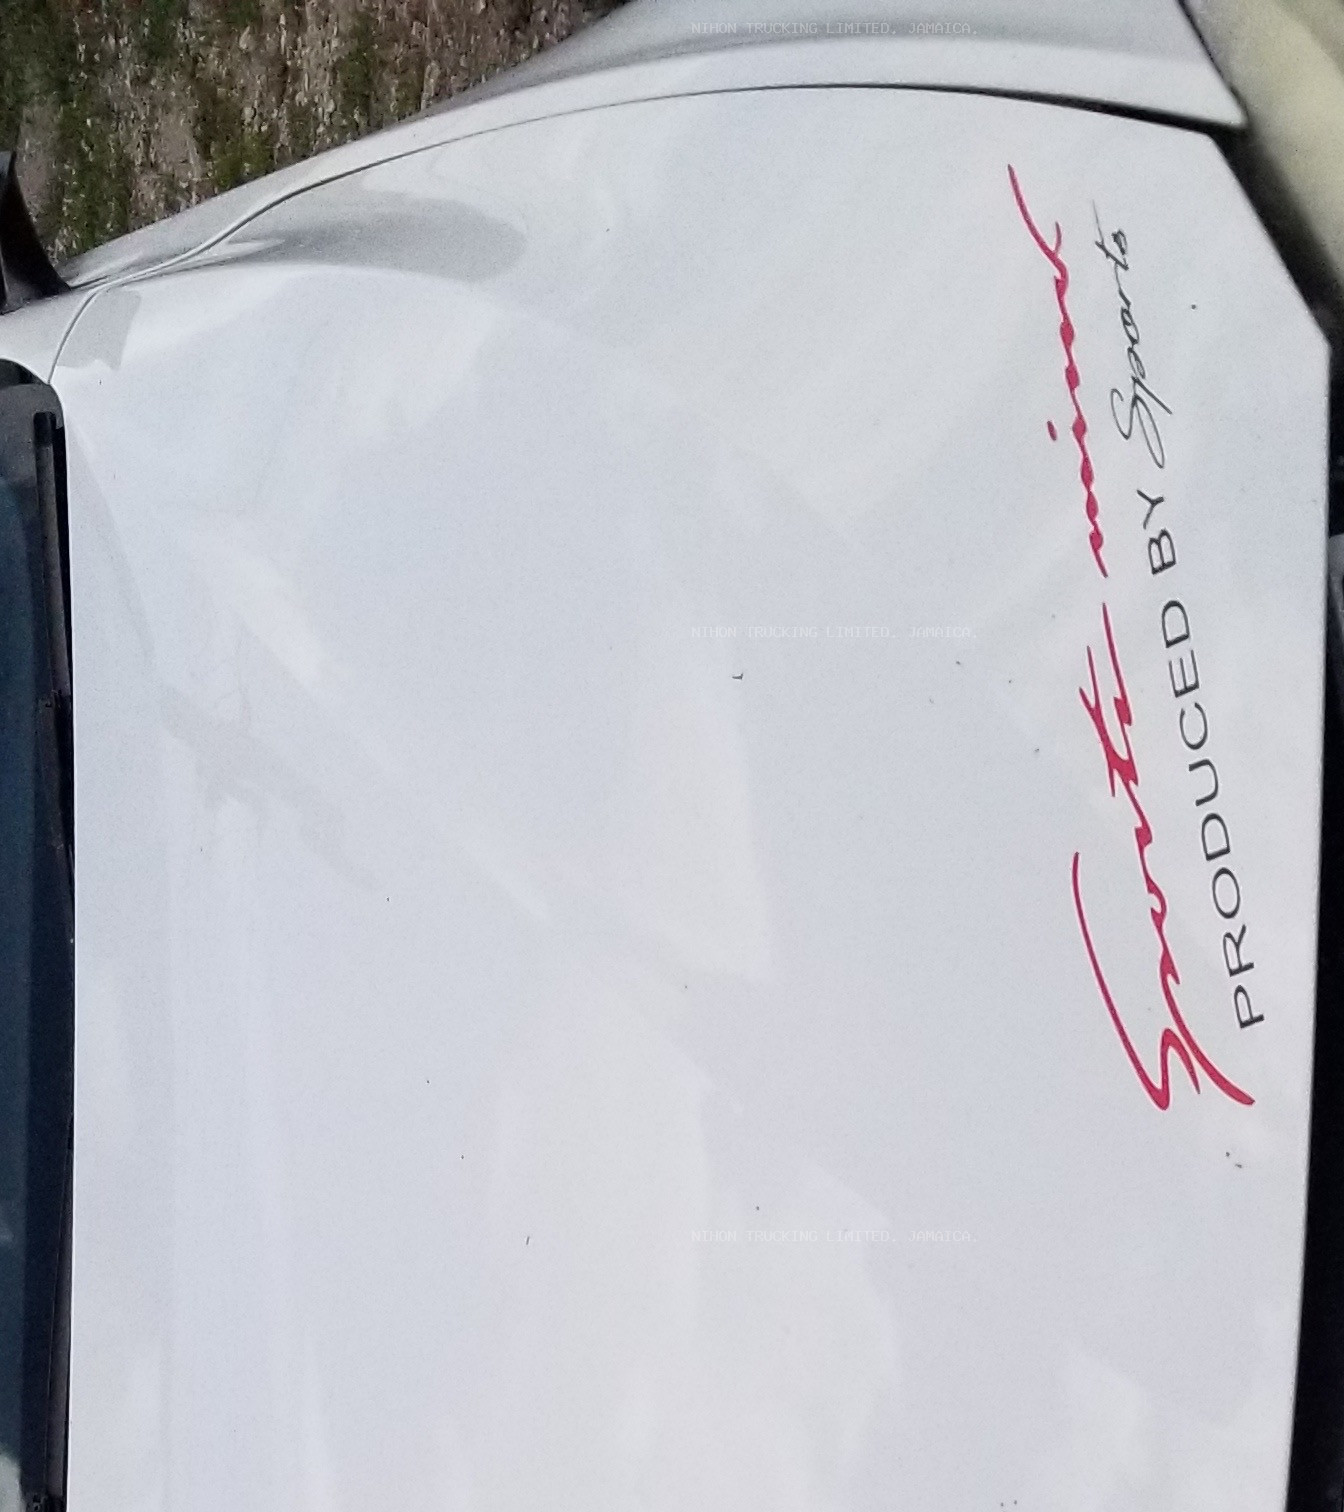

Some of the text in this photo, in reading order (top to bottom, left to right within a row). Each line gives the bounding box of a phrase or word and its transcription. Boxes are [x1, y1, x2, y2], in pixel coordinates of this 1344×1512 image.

[1092, 202, 1266, 1031] PRODUCED BY Sports
